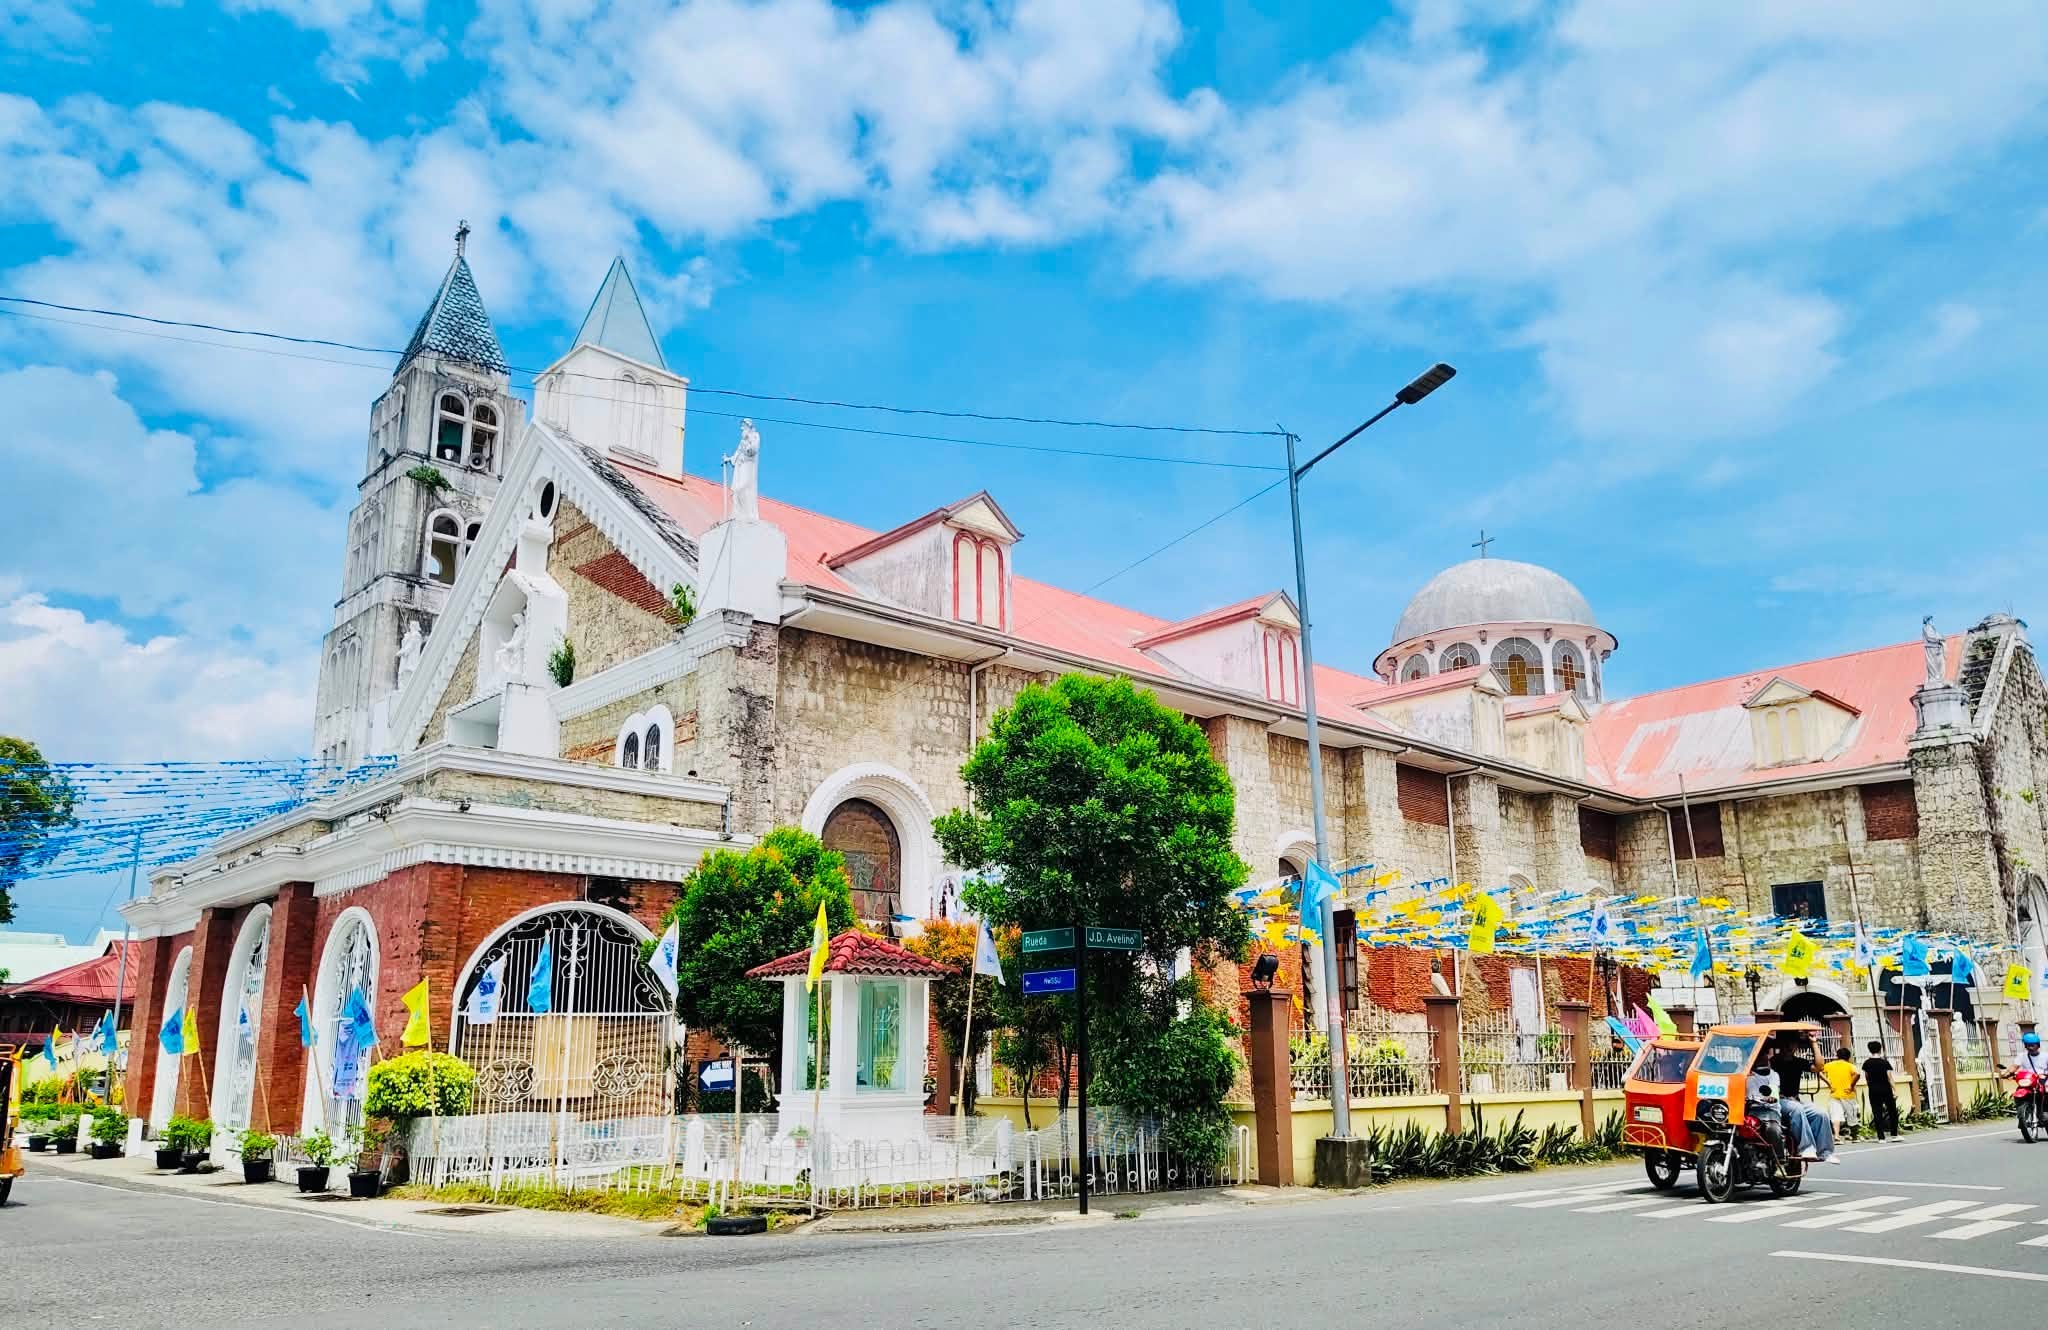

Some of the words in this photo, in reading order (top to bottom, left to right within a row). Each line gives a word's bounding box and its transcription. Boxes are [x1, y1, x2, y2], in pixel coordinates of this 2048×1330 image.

[1025, 936, 1047, 947] Rueda
[1089, 932, 1105, 943] J.D.
[1106, 933, 1135, 945] Avelino
